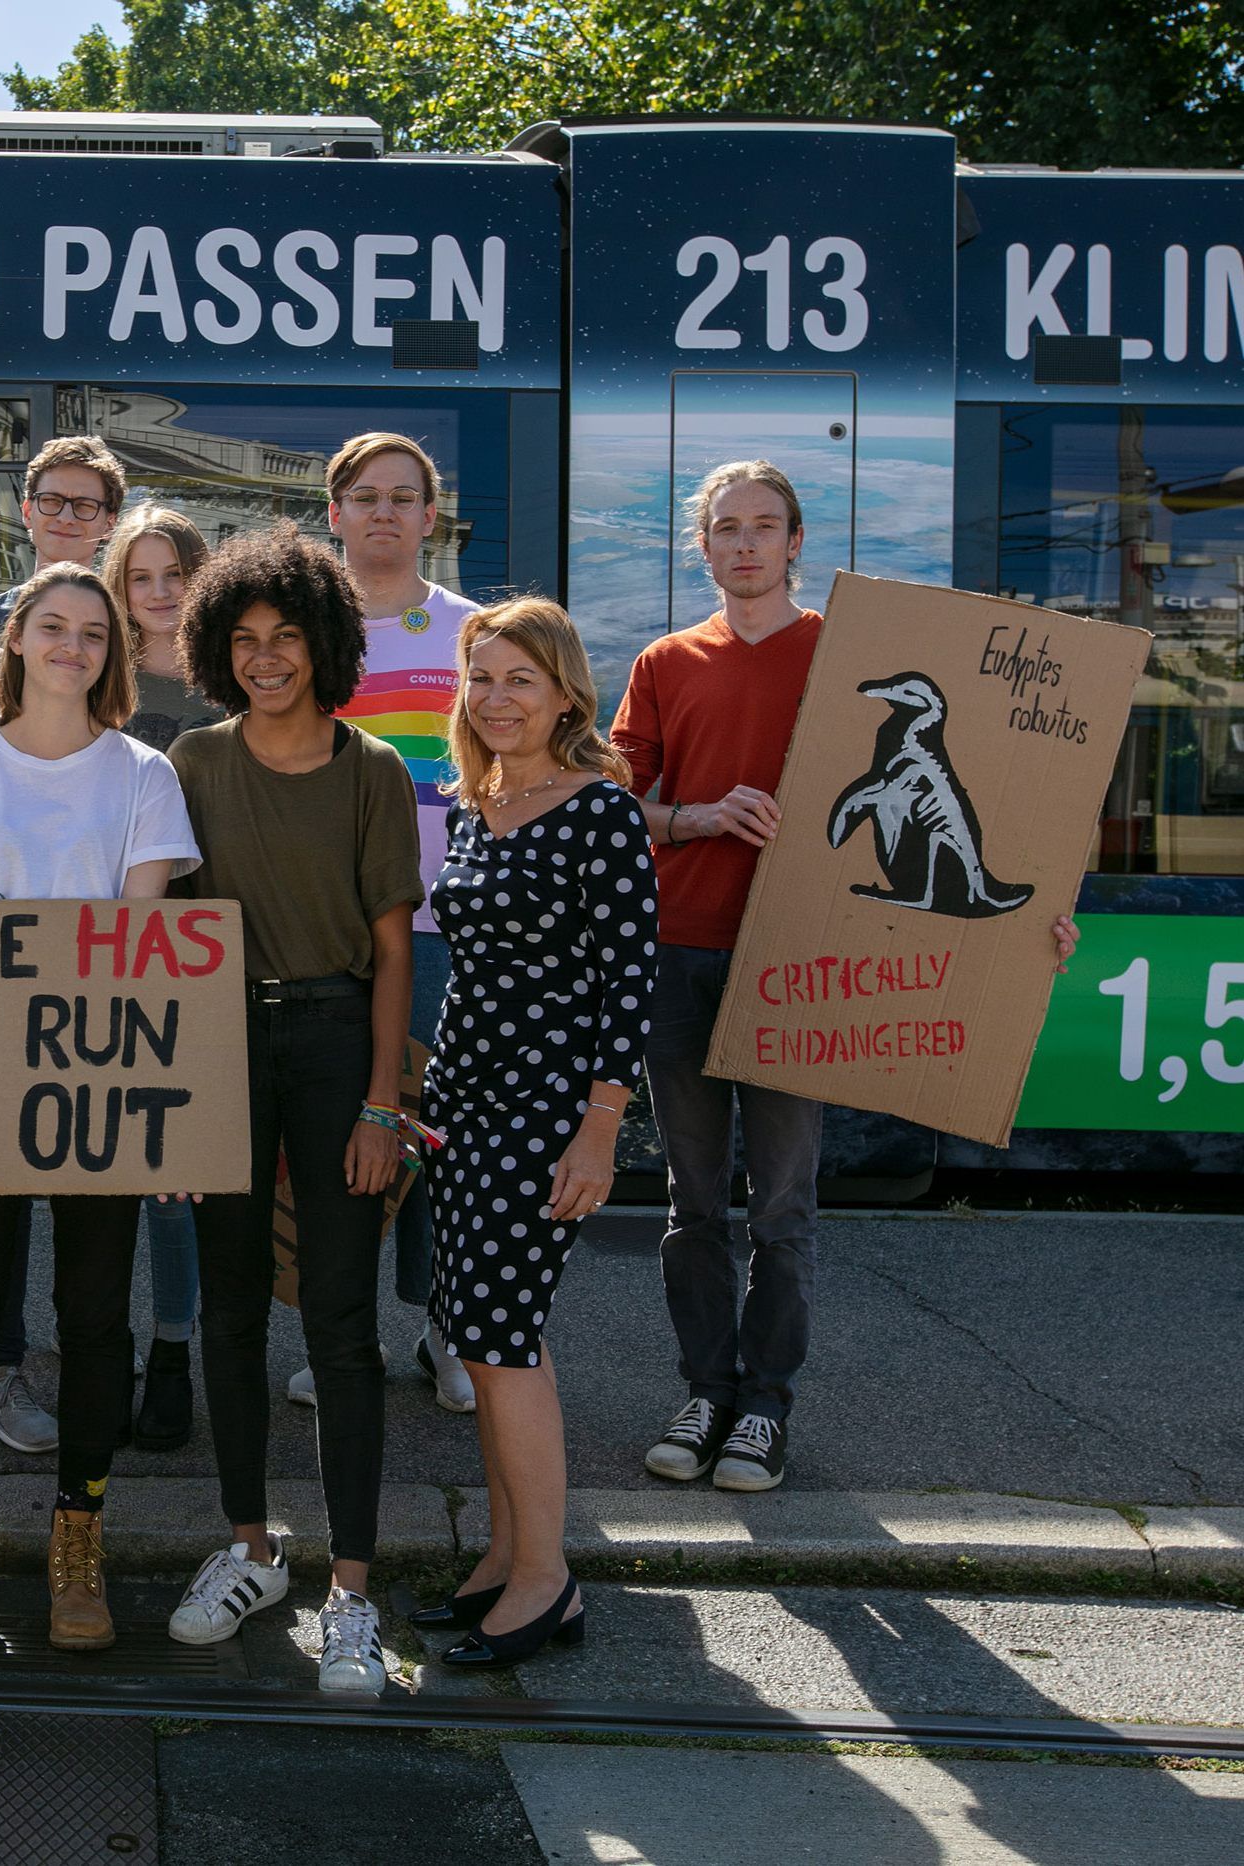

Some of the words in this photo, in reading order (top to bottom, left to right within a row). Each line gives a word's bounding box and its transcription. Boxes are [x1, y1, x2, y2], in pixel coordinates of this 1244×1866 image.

[43, 225, 506, 352] PASSEN
[675, 235, 869, 352] 213
[980, 626, 1062, 698] Eudyptes
[1008, 692, 1088, 745] robutus
[77, 904, 226, 979] HAS
[758, 951, 952, 1006] CRITICALLY
[24, 993, 180, 1070] RUN
[755, 1019, 965, 1065] ENDANGERED
[18, 1081, 193, 1173] OUT
